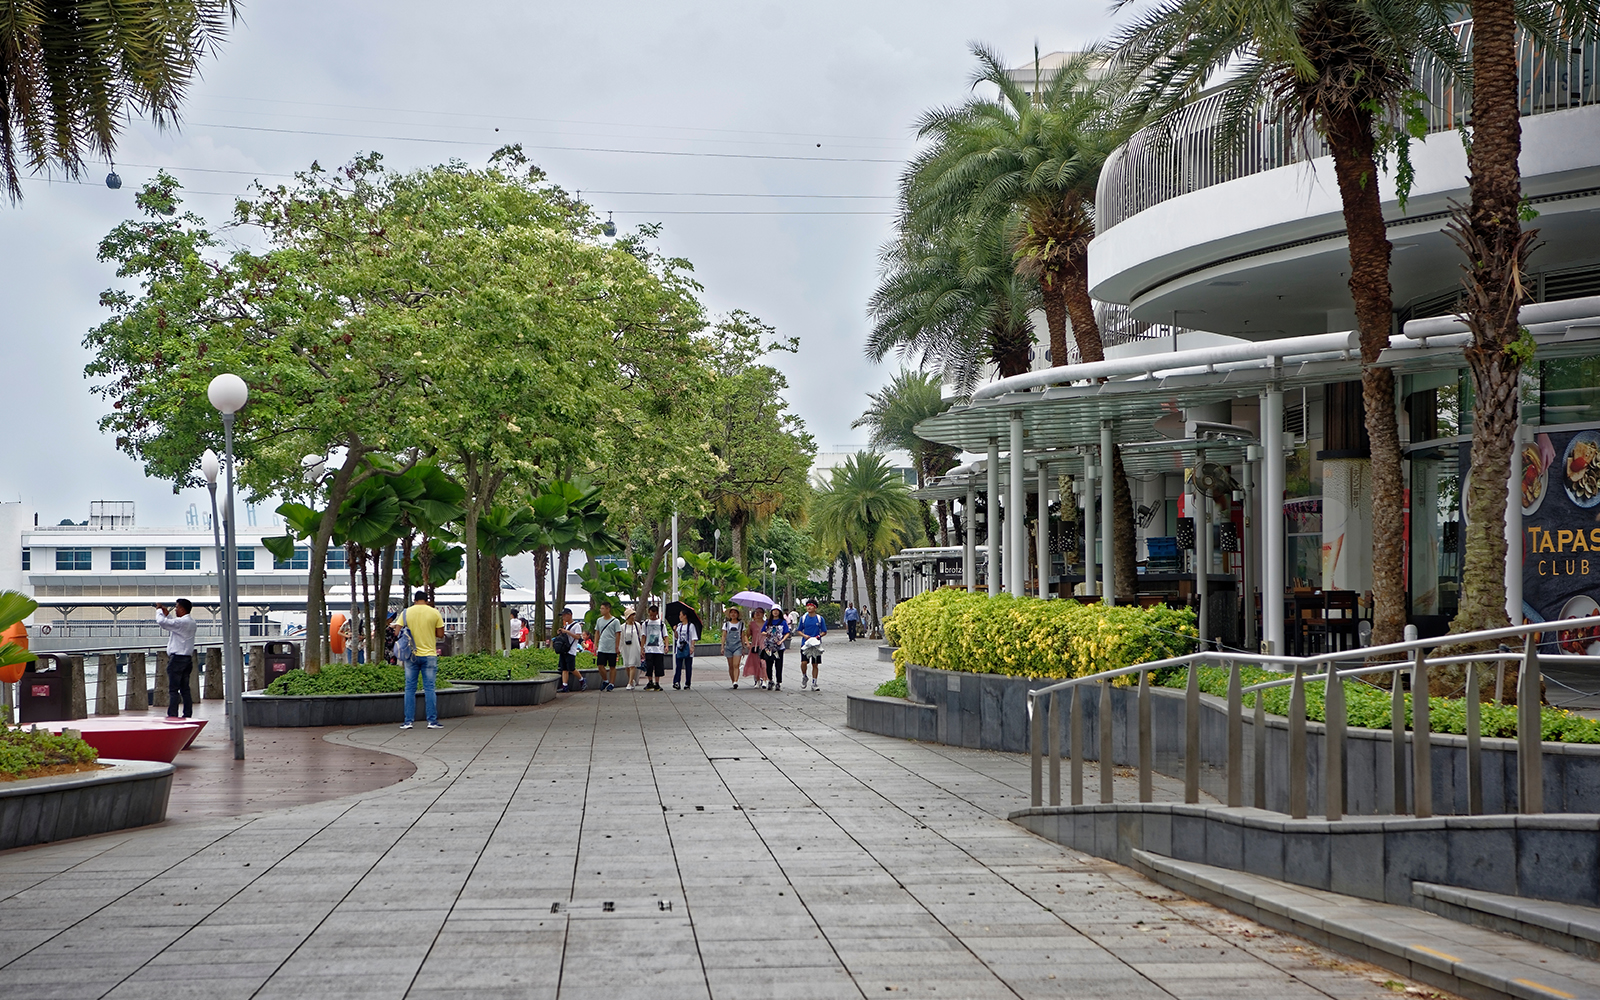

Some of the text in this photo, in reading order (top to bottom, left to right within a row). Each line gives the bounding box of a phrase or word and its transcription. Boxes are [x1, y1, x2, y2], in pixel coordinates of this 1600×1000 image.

[1528, 526, 1600, 553] TAPAS
[944, 561, 963, 574] brotz
[1538, 559, 1590, 576] CLUB
